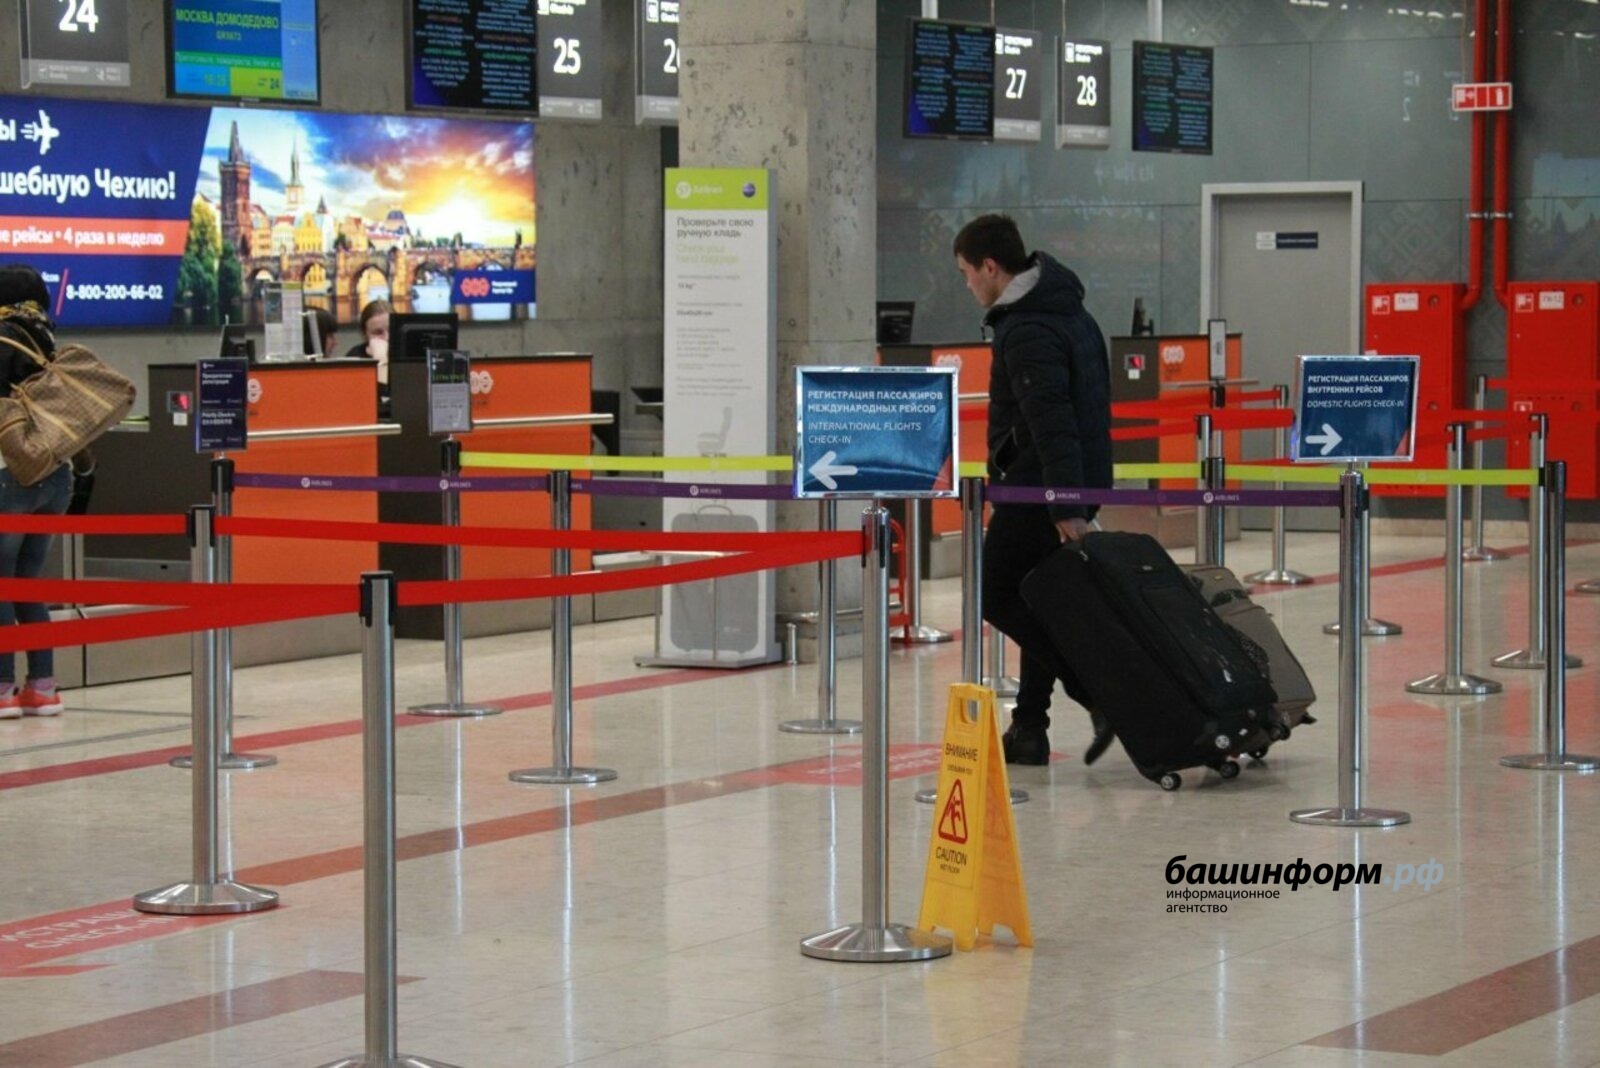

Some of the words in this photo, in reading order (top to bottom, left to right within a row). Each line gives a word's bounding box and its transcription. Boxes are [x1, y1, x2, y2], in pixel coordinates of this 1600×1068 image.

[58, 0, 99, 33] 24
[176, 8, 214, 24] МОСКВА
[216, 12, 279, 29] ДОМОДЕДОВО
[553, 37, 581, 75] 25
[1006, 67, 1026, 99] 27
[1077, 75, 1097, 106] 28
[94, 168, 175, 200] Чехию!
[677, 217, 726, 228] Проверьте
[12, 226, 53, 246] рейсы
[64, 228, 72, 243] 4
[75, 232, 104, 247] раза
[117, 233, 164, 247] неделю
[677, 229, 711, 238] ручную
[714, 229, 741, 238] кладь
[66, 284, 163, 300] 8-800-200-66-02
[1308, 375, 1358, 383] РЕГИСТРАЦИЯ
[808, 390, 875, 401] РЕГИСТРАЦИЯ
[877, 391, 943, 400] ПАССАЖИРОВ
[1356, 384, 1383, 393] РЕЙСОВ
[808, 403, 897, 413] МЕЖДУНАРОДНЫХ
[899, 402, 936, 413] РЕЙСОВ
[1307, 400, 1342, 408] DOMESTIC
[1343, 400, 1372, 408] FLIGHTS
[808, 421, 882, 431] INTERNATIONAL
[883, 421, 921, 431] FLIGHTS
[808, 434, 851, 444] CHECK-IN
[945, 742, 978, 761] ВНИМАНИЕ
[935, 846, 967, 866] CAUTION
